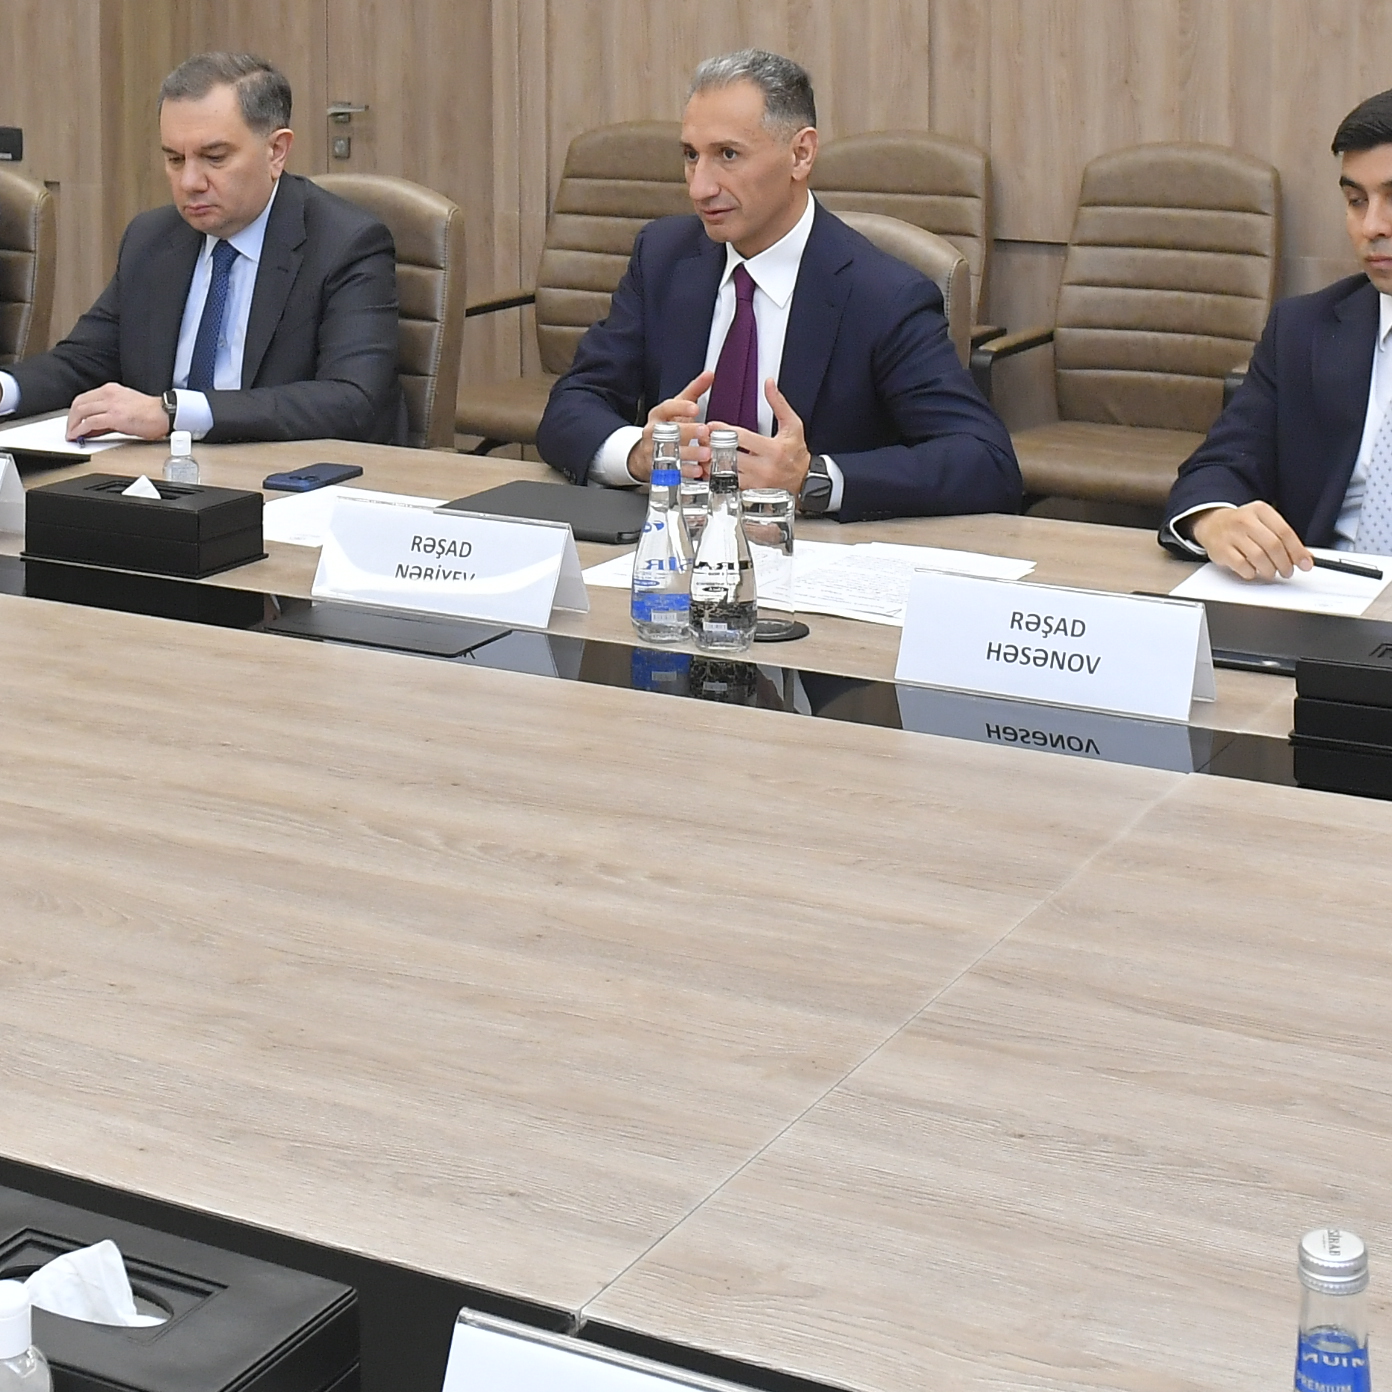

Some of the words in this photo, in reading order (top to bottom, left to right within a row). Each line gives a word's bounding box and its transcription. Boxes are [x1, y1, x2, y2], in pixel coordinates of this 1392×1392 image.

[410, 535, 472, 559] RƏŞAD
[1010, 611, 1086, 639] RƏŞAD
[986, 641, 1101, 675] HƏSƏNOV
